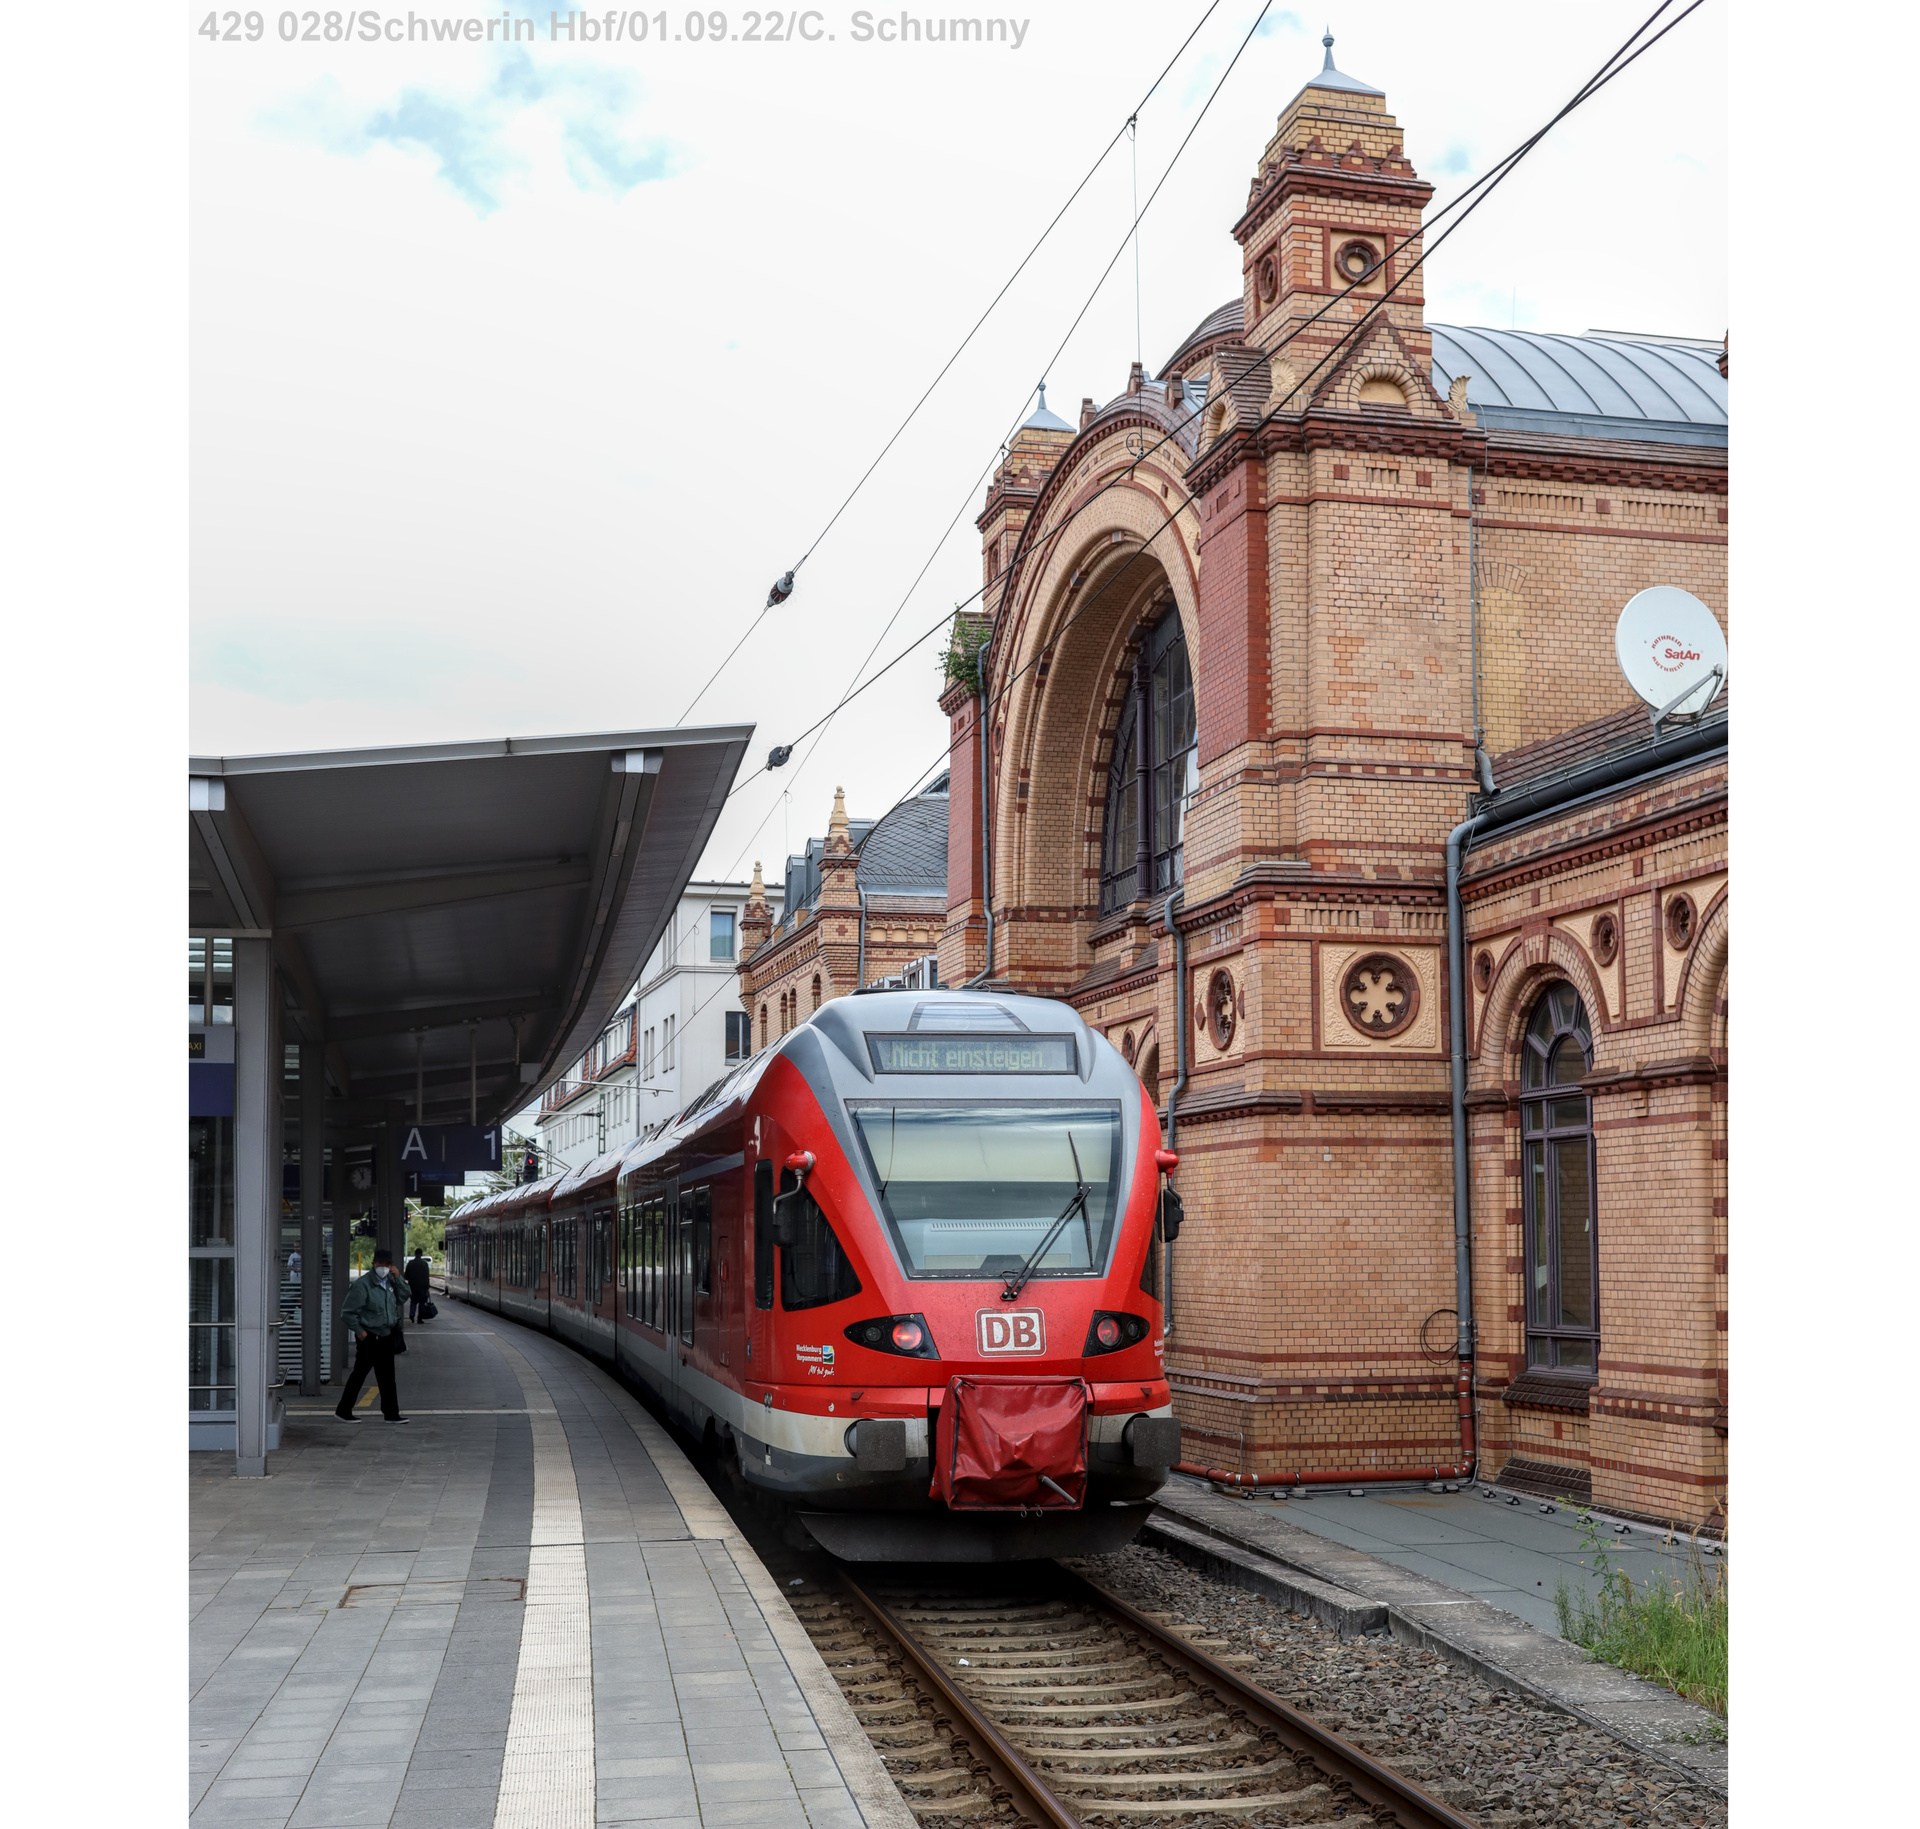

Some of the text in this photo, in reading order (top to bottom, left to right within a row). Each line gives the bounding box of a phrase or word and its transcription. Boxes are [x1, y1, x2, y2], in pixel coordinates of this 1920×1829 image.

[1664, 648, 1700, 661] SatAn
[892, 1042, 1044, 1071] Nicht einsteigen
[401, 1127, 496, 1161] A 1
[409, 1172, 418, 1192] 1
[984, 1315, 1038, 1349] DB
